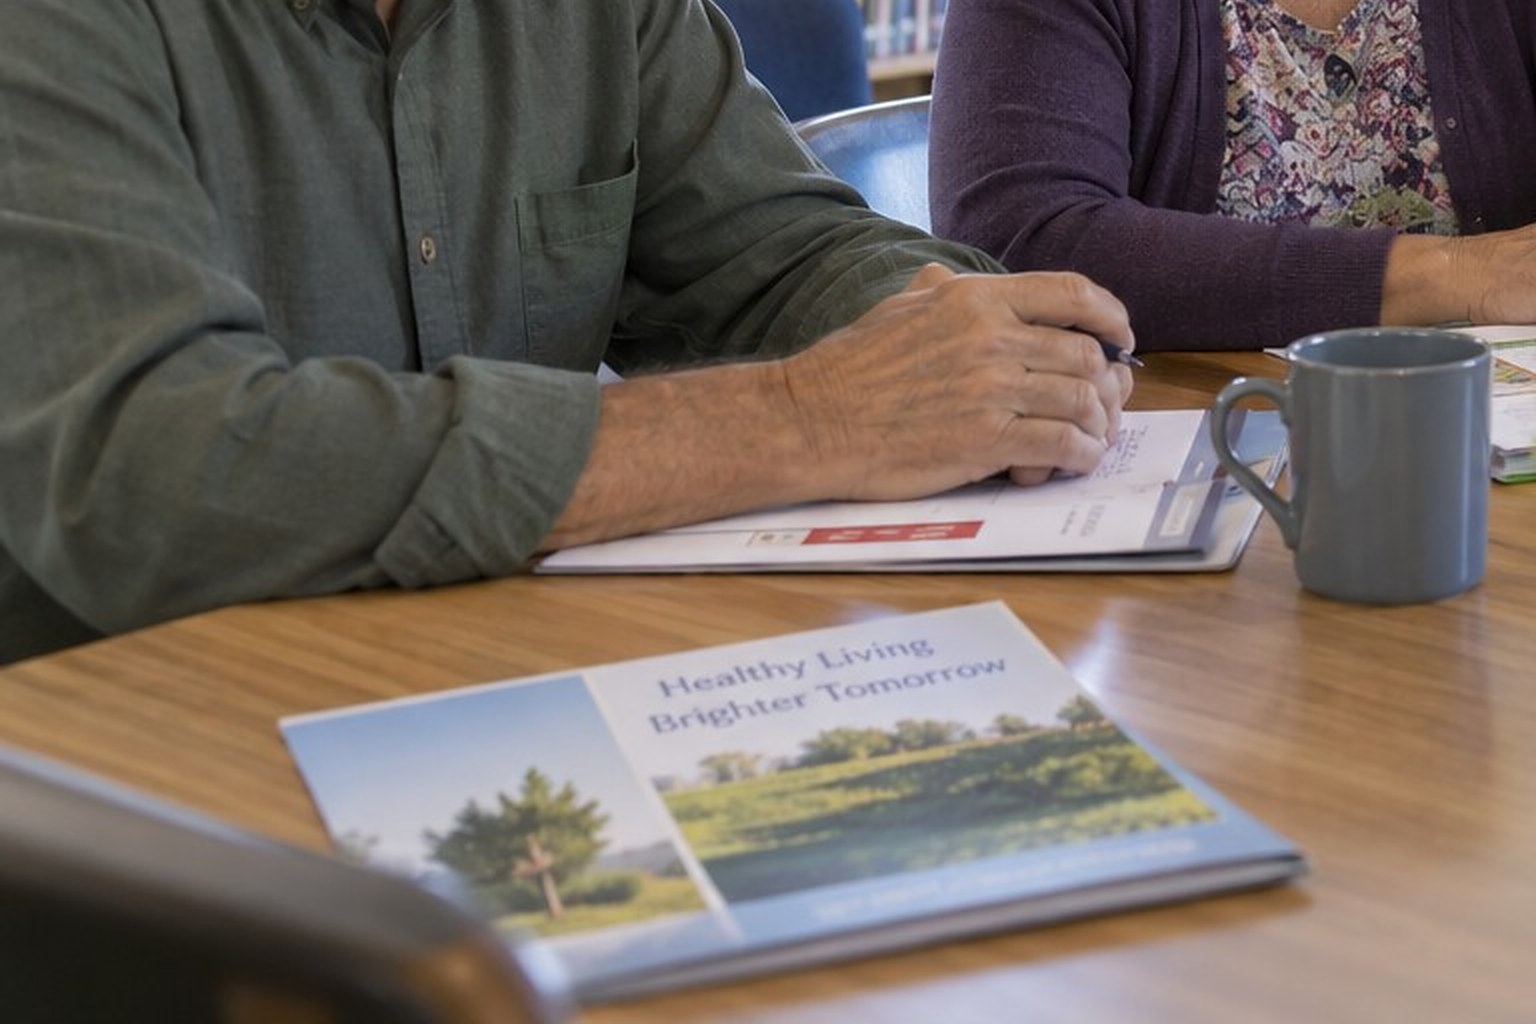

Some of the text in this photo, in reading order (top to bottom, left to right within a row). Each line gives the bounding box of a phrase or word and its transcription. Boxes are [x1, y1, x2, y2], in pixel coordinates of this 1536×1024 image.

[648, 658, 1006, 735] Brighter Tomorrow
[657, 637, 935, 698] Healthy Living
